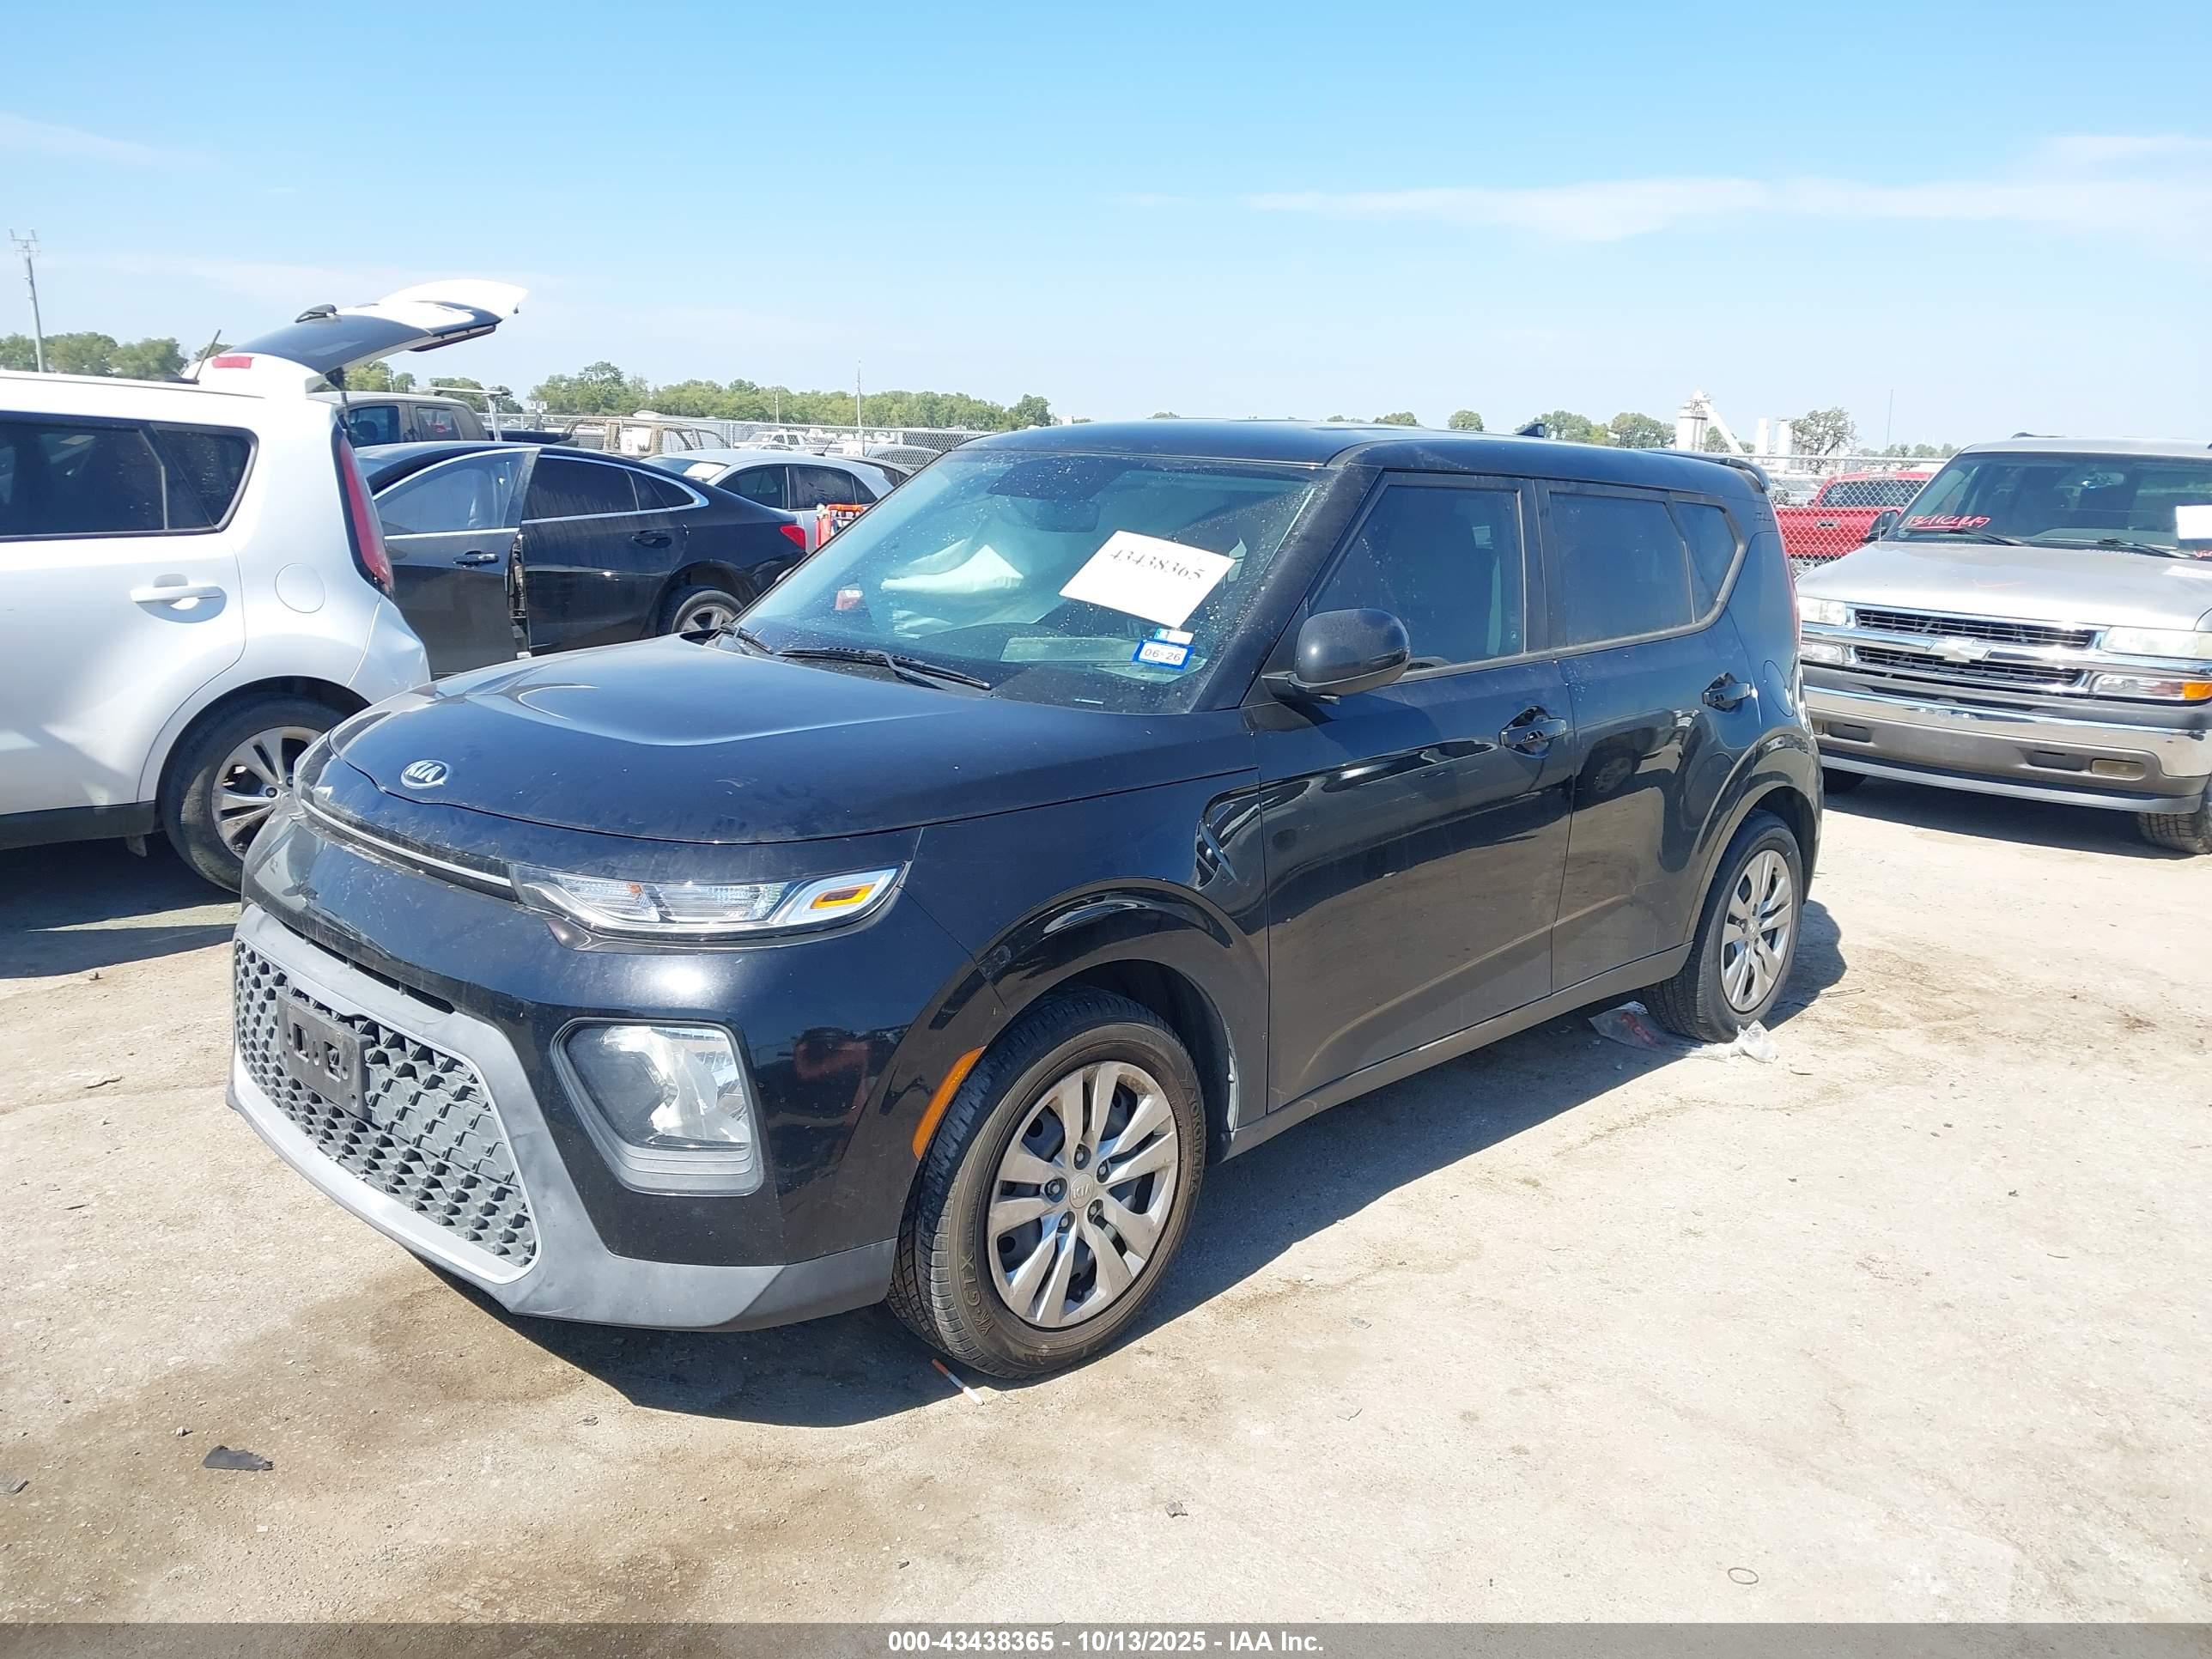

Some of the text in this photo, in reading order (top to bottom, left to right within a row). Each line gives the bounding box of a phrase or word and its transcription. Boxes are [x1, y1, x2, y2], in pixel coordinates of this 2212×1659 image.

[1110, 550, 1205, 580] 43438365
[404, 762, 443, 783] KIA
[1071, 1182, 1091, 1199] KIA
